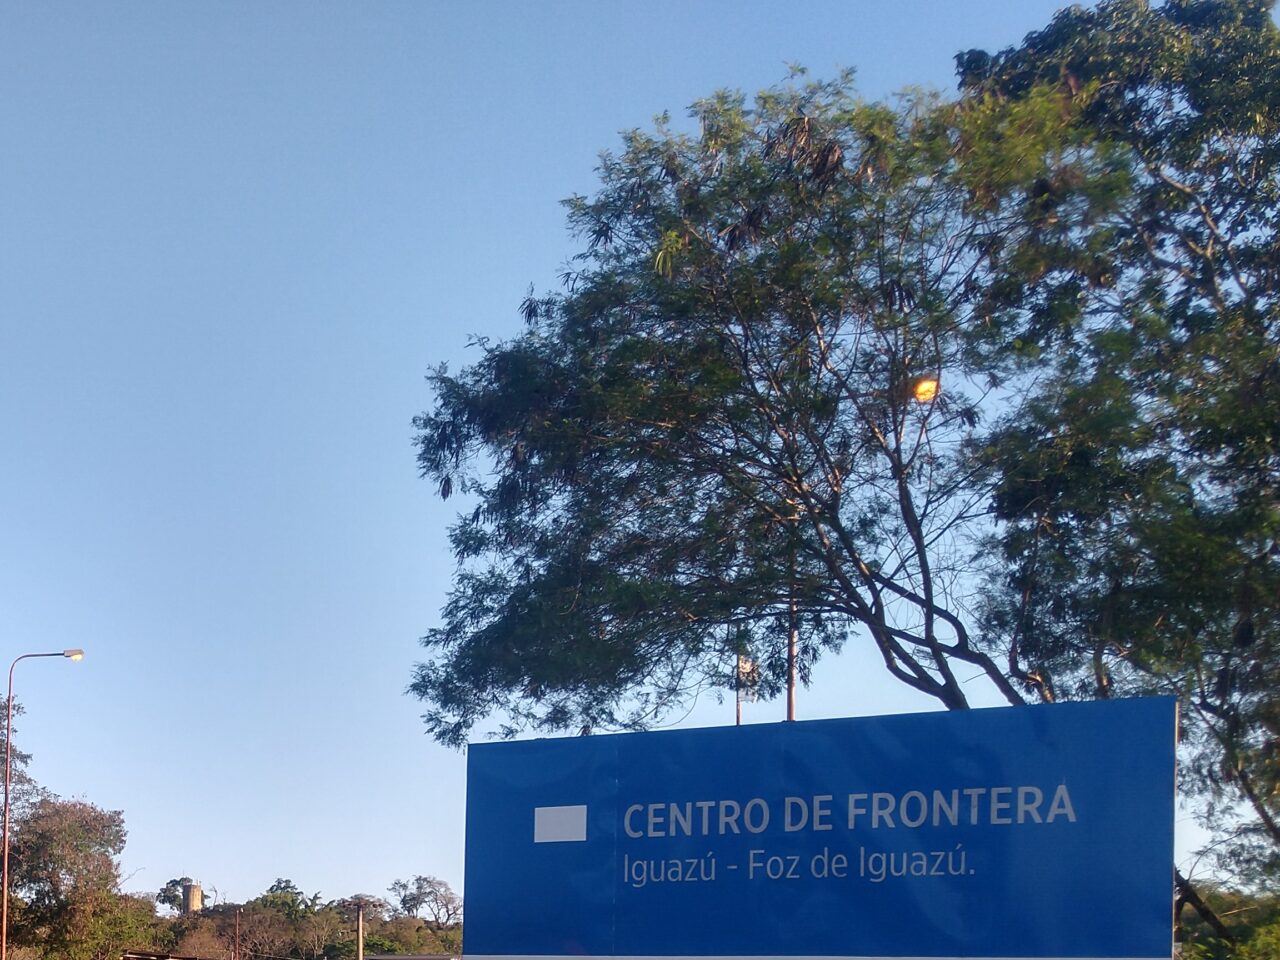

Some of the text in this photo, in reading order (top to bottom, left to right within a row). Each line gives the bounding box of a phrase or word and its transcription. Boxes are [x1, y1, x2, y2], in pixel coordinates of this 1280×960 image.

[623, 784, 1078, 839] CENTRO DE FRONTERA
[623, 851, 716, 888] Iguazú
[748, 849, 801, 881] Foz
[810, 846, 848, 878] de
[859, 843, 976, 883] Iguazú.
